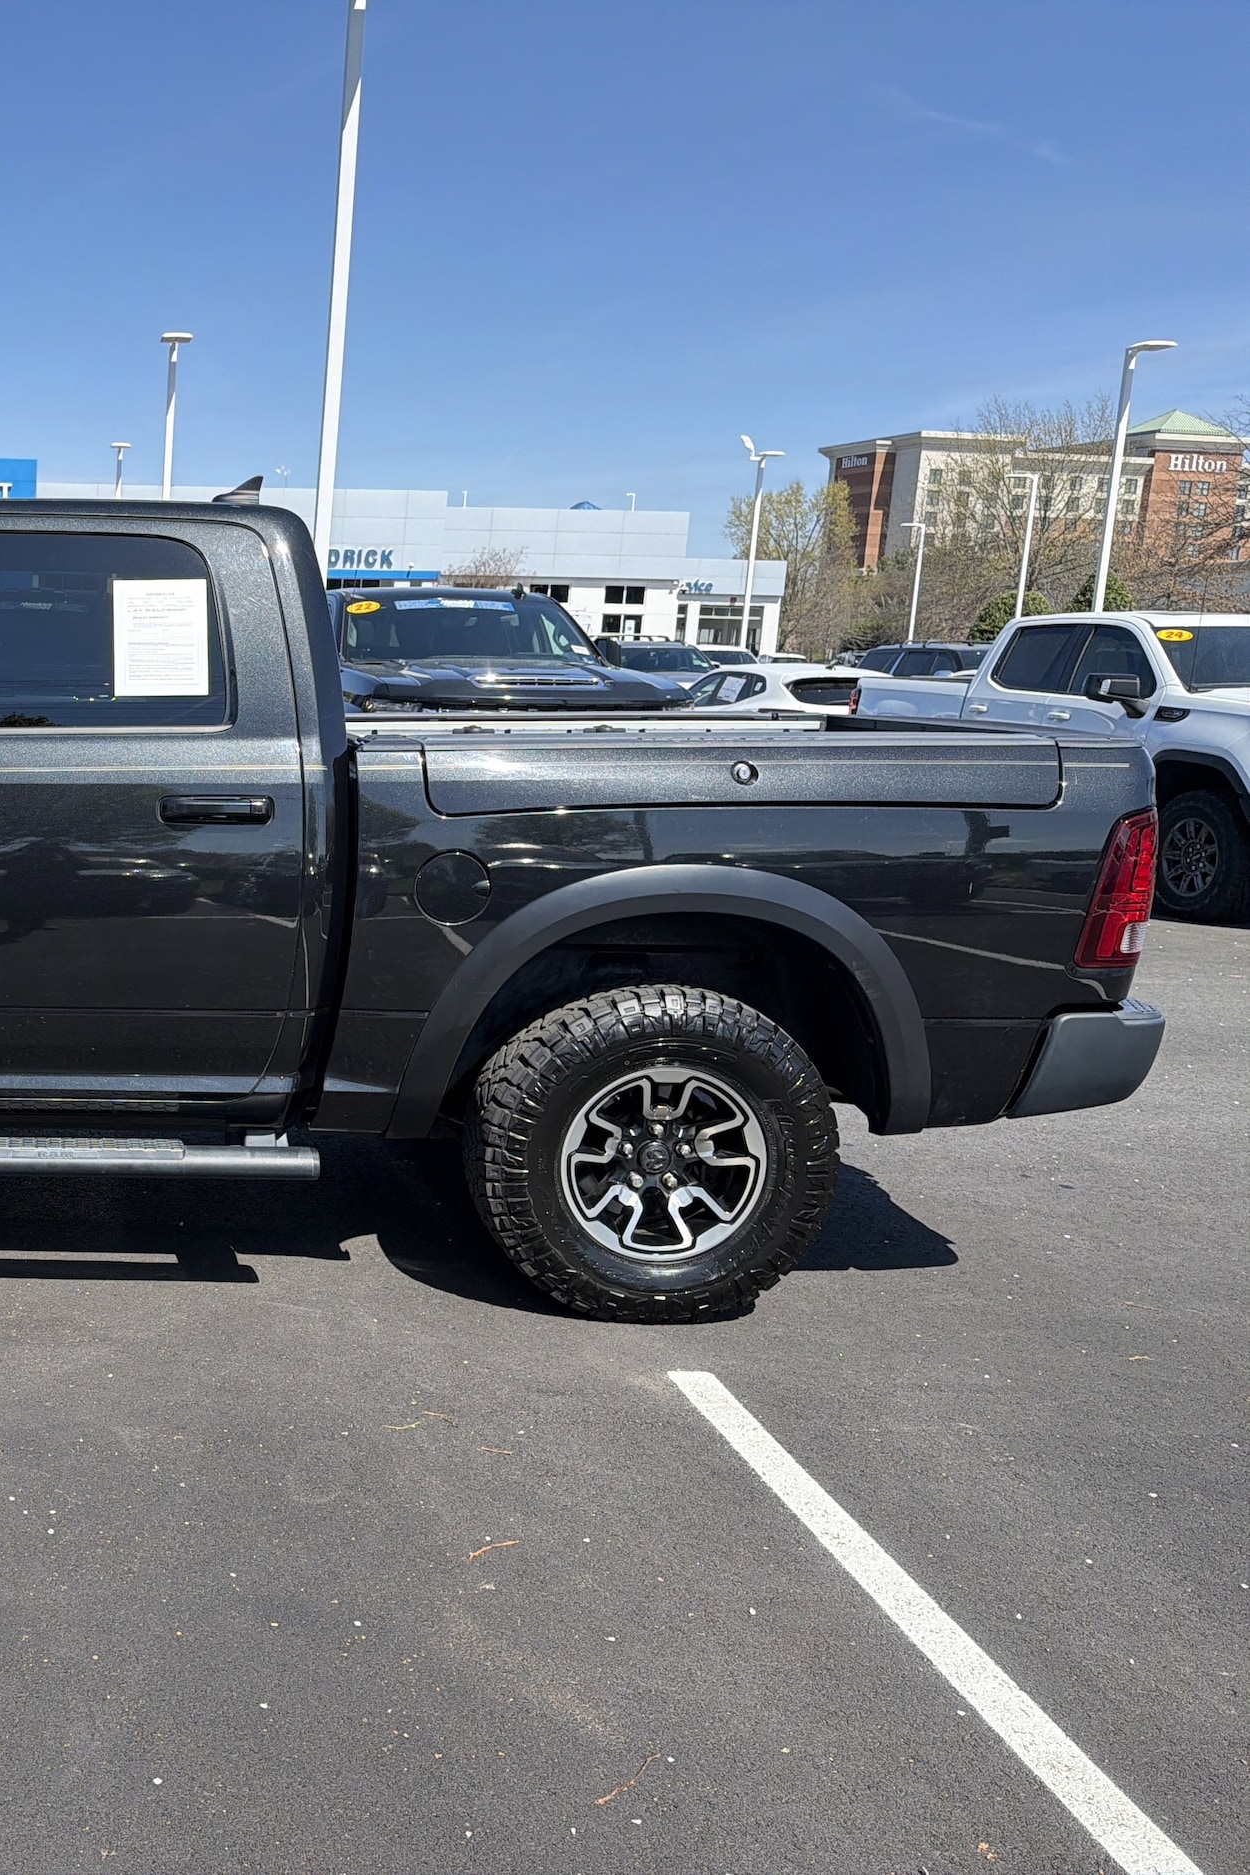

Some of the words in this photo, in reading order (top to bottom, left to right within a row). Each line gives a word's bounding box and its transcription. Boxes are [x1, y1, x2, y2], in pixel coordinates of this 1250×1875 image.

[841, 456, 868, 468] Hilton
[1168, 453, 1227, 473] Hilton
[354, 602, 373, 611] 22
[1165, 631, 1184, 639] 24
[36, 1151, 74, 1159] RAM
